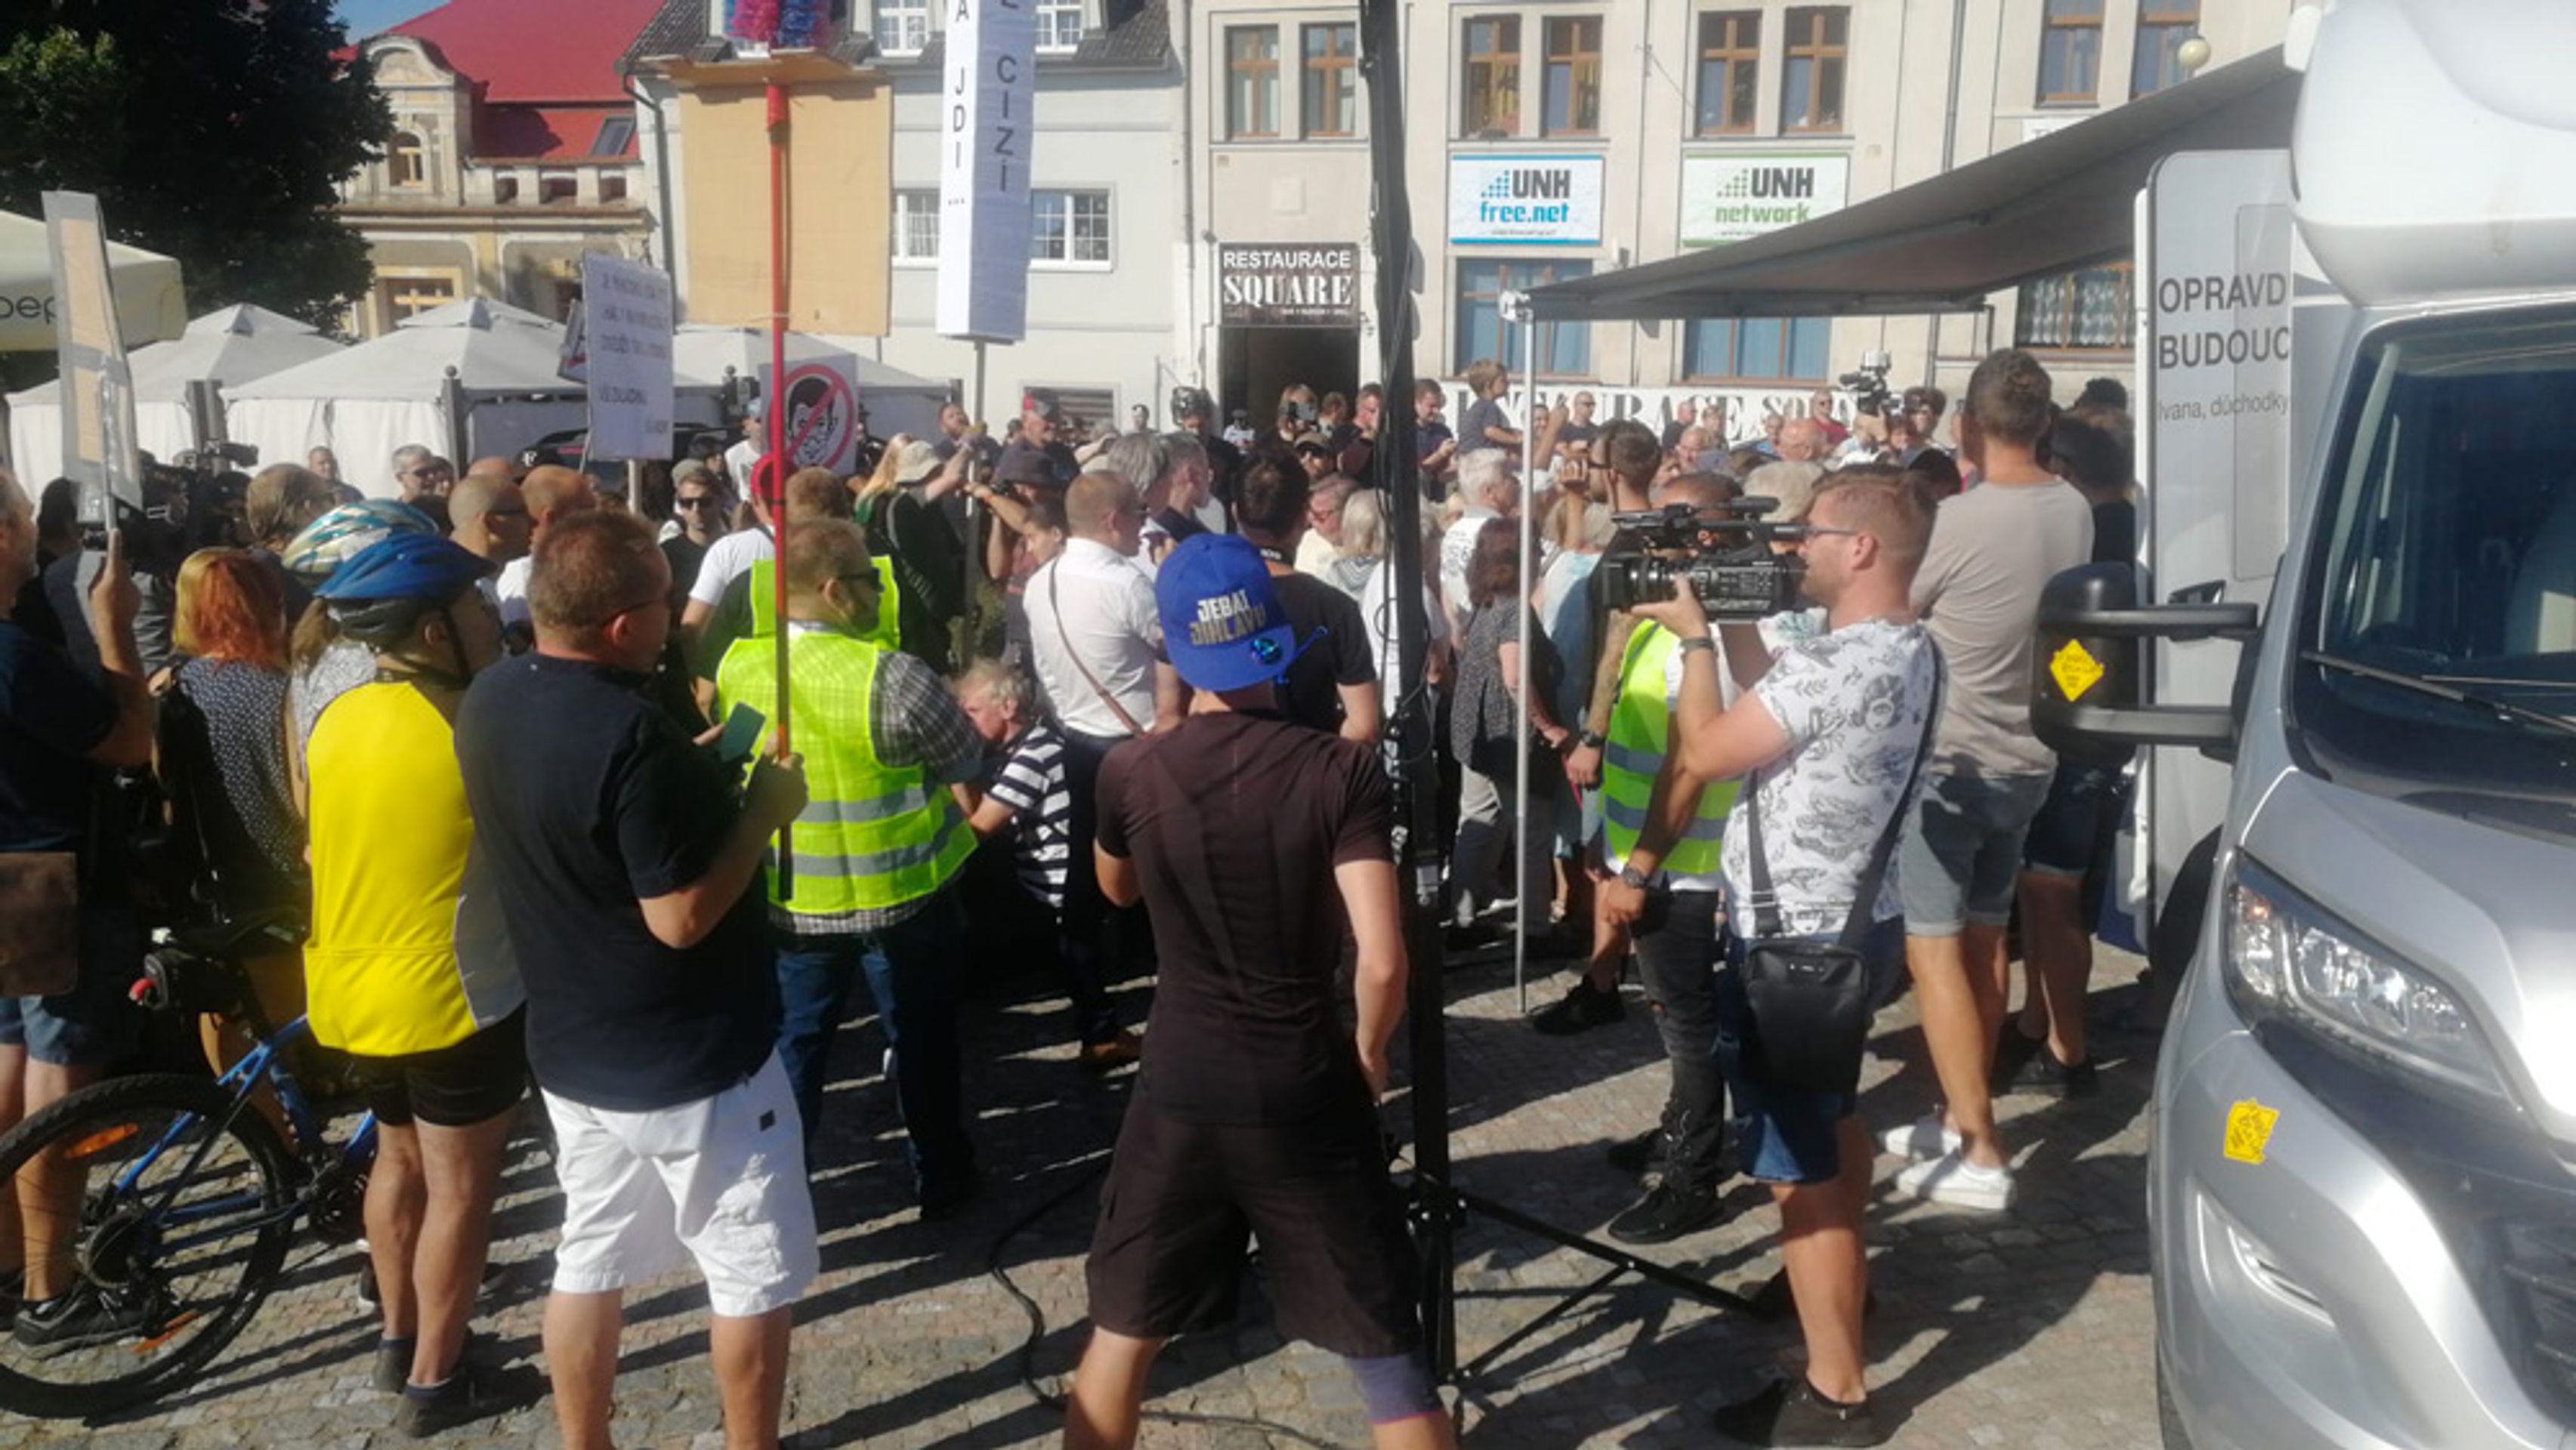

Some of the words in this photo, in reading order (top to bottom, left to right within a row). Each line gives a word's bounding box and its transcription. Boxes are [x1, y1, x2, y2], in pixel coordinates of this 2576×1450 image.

[953, 66, 966, 168] JDI
[994, 55, 1018, 192] CIZÍ
[1512, 169, 1571, 199] UNH
[1751, 167, 1815, 198] UNH
[1480, 201, 1569, 223] free.net
[1716, 202, 1809, 223] network
[1223, 251, 1351, 269] RESTAURACE
[1223, 275, 1351, 307] SQUARE
[2159, 273, 2287, 313] OPRAVD
[2159, 326, 2289, 370] BUDOUC
